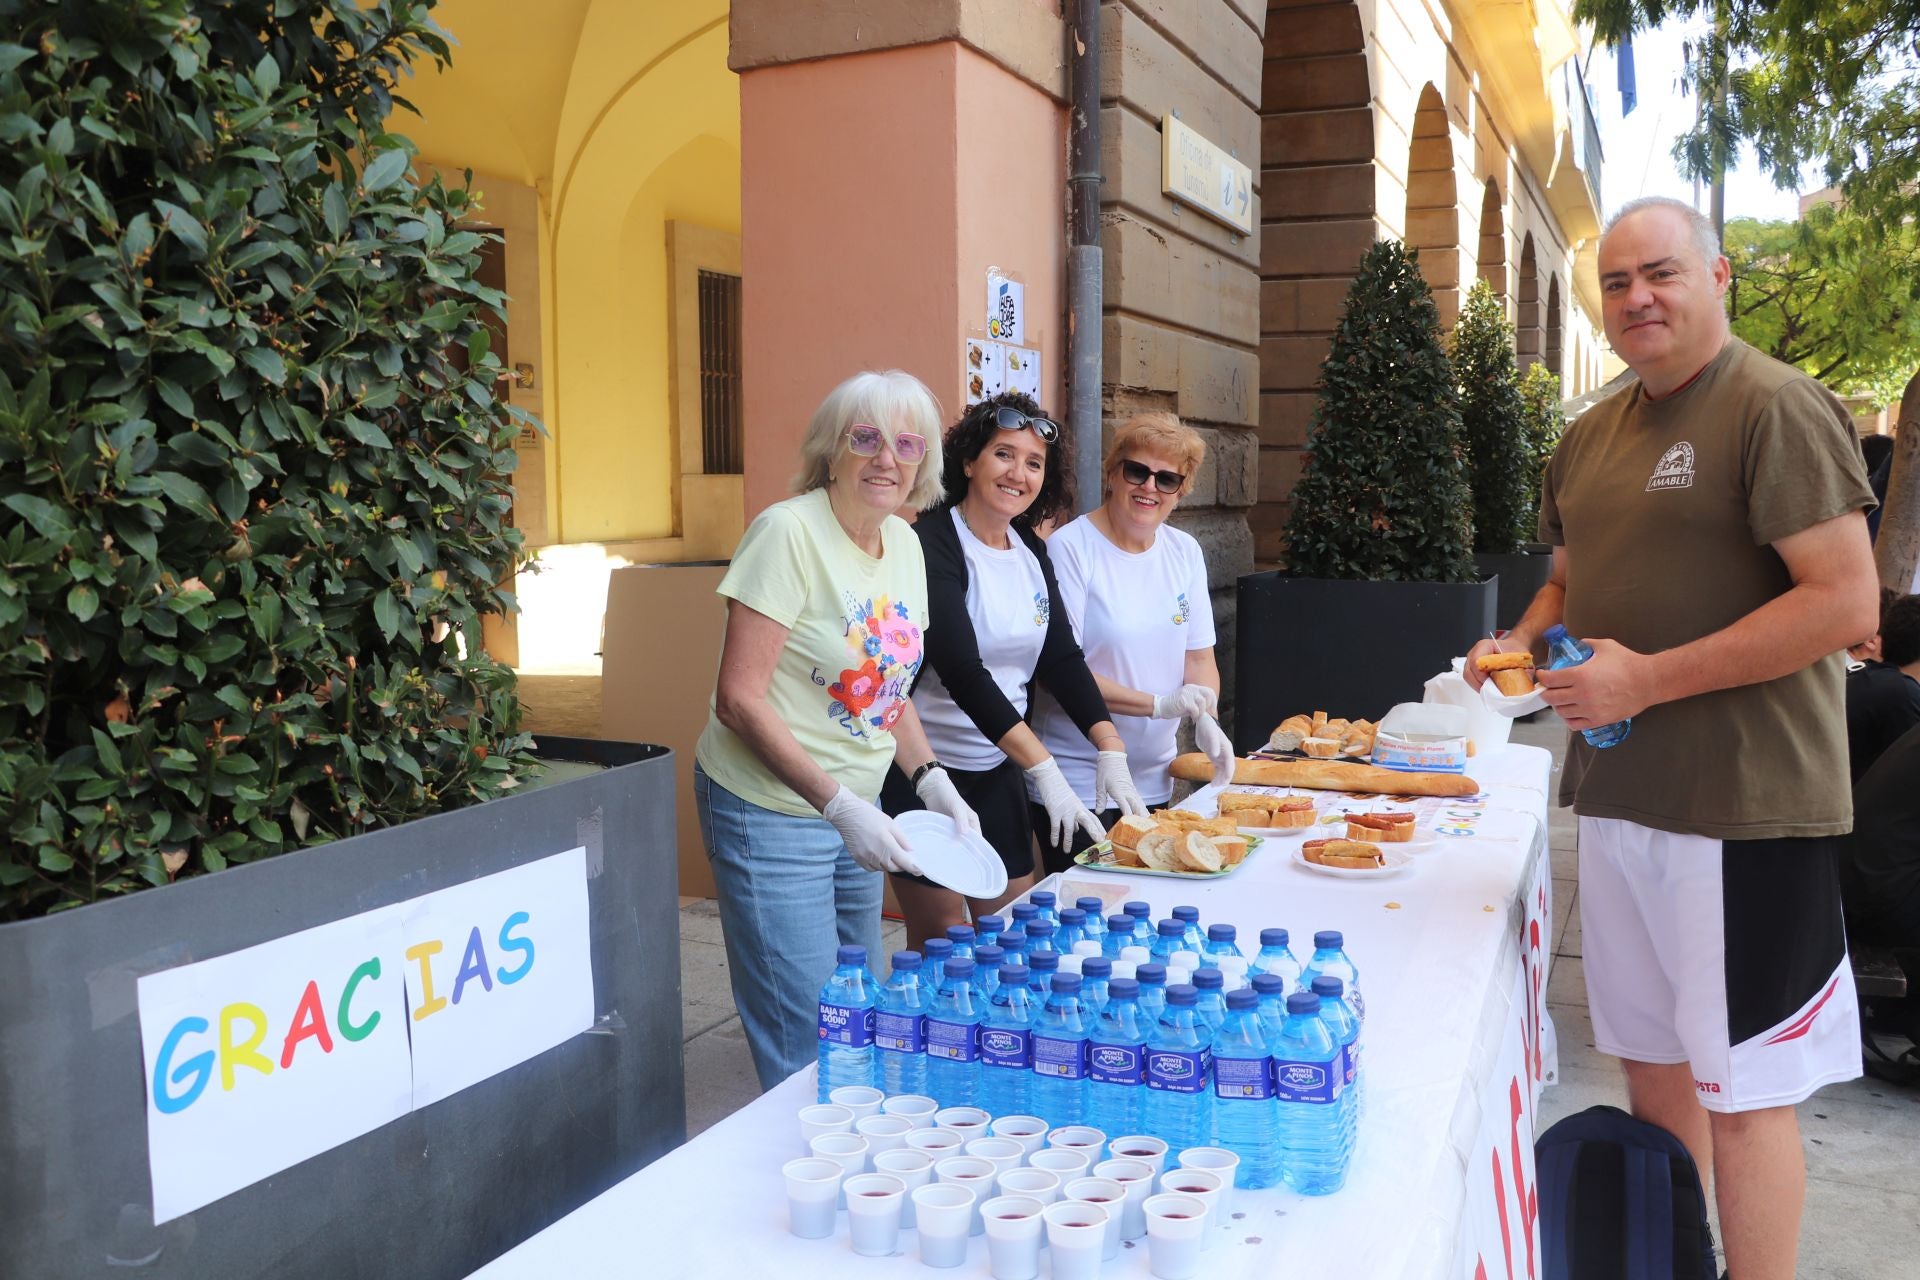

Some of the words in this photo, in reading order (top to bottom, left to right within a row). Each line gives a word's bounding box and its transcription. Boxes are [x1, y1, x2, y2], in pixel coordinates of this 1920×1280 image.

[1651, 476, 1688, 487] AMABLE
[152, 911, 535, 1115] GRACIAS
[820, 1004, 838, 1016] BAJA
[839, 1008, 850, 1018] EN
[822, 1014, 847, 1026] SODIO
[991, 1033, 1012, 1041] MONTE
[1101, 1049, 1124, 1057] MONTE
[1104, 1054, 1124, 1062] PINOS
[1160, 1056, 1182, 1064] MONTE
[1162, 1061, 1183, 1069] PINOS
